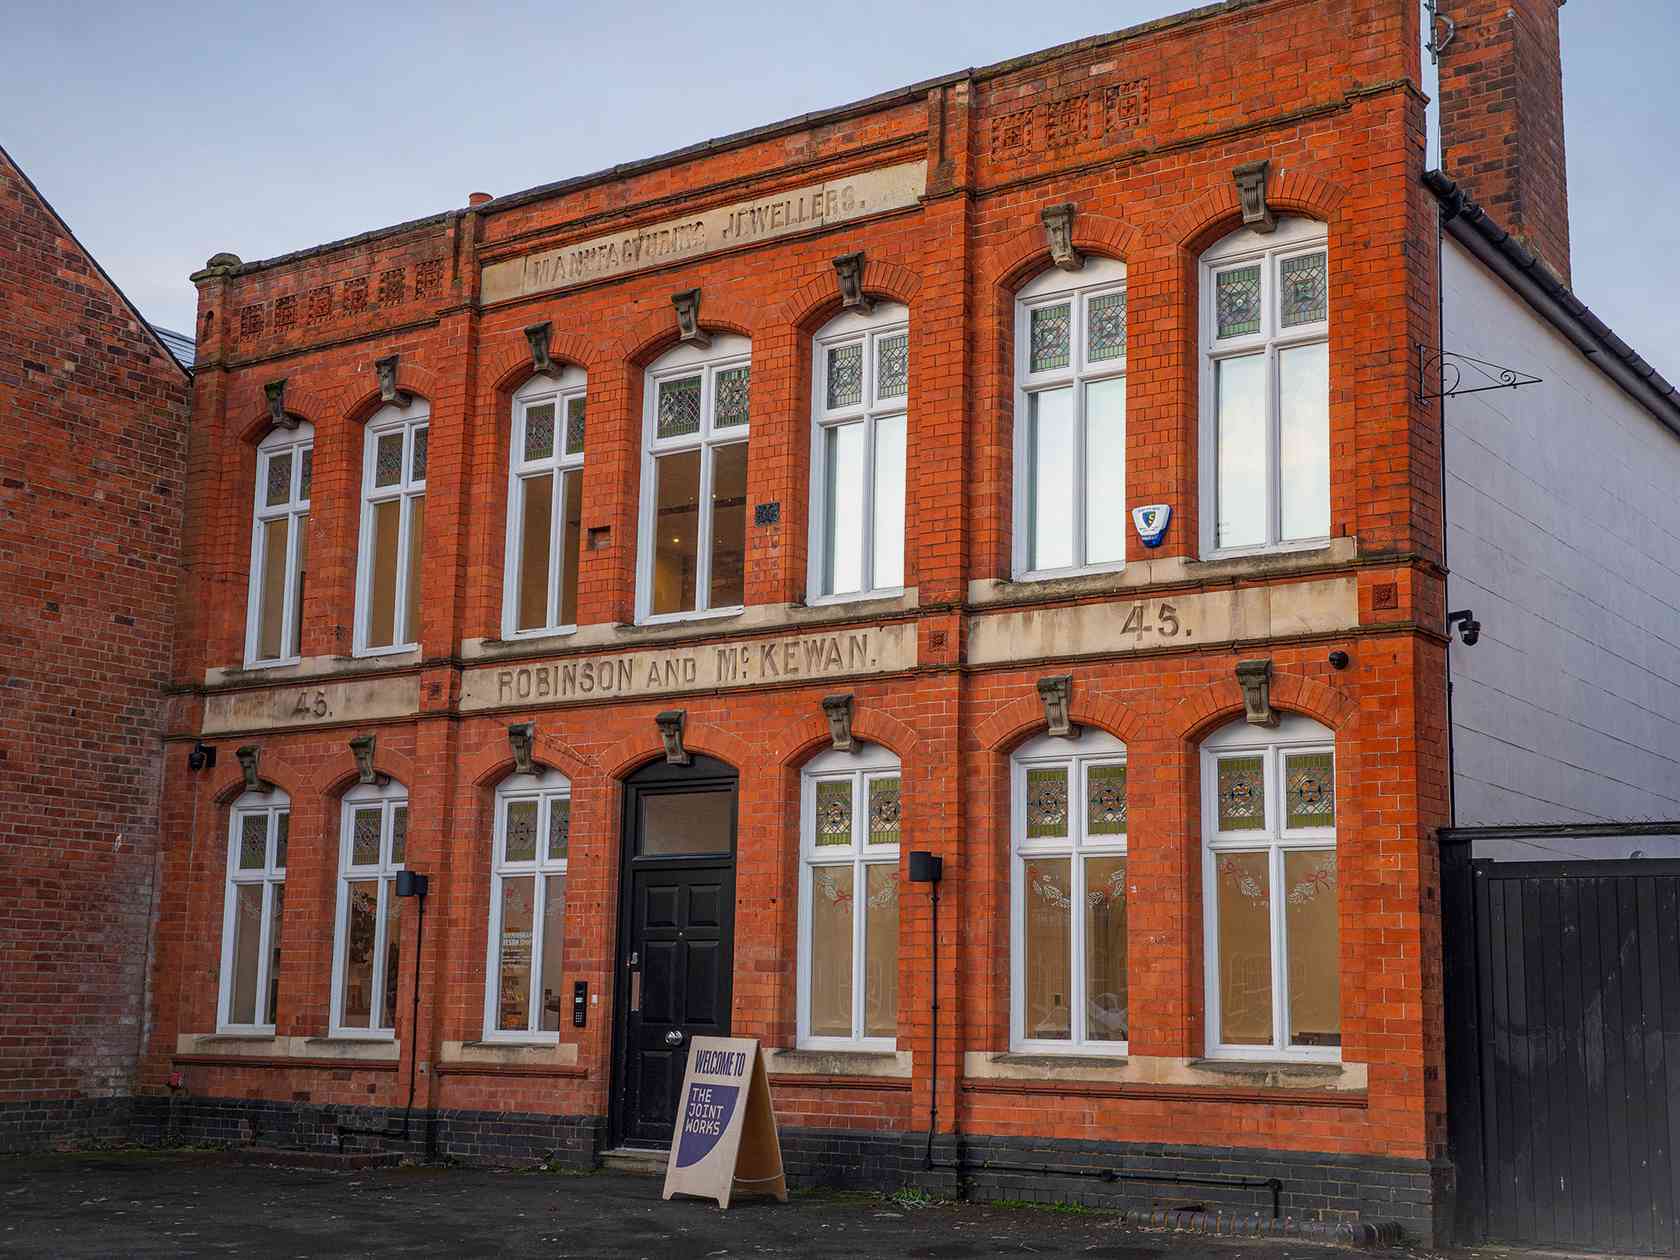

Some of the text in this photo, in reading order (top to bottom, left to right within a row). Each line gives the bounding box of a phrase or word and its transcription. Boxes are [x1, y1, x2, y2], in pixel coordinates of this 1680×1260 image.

[1120, 602, 1193, 642] 45.
[497, 658, 634, 702] ROBINSON
[647, 657, 697, 689] AND
[760, 633, 877, 679] KEWAN.
[694, 1049, 746, 1077] WELCOME TO
[692, 1087, 713, 1103] THE
[688, 1102, 724, 1121] JOINT
[685, 1118, 721, 1136] WORKS
